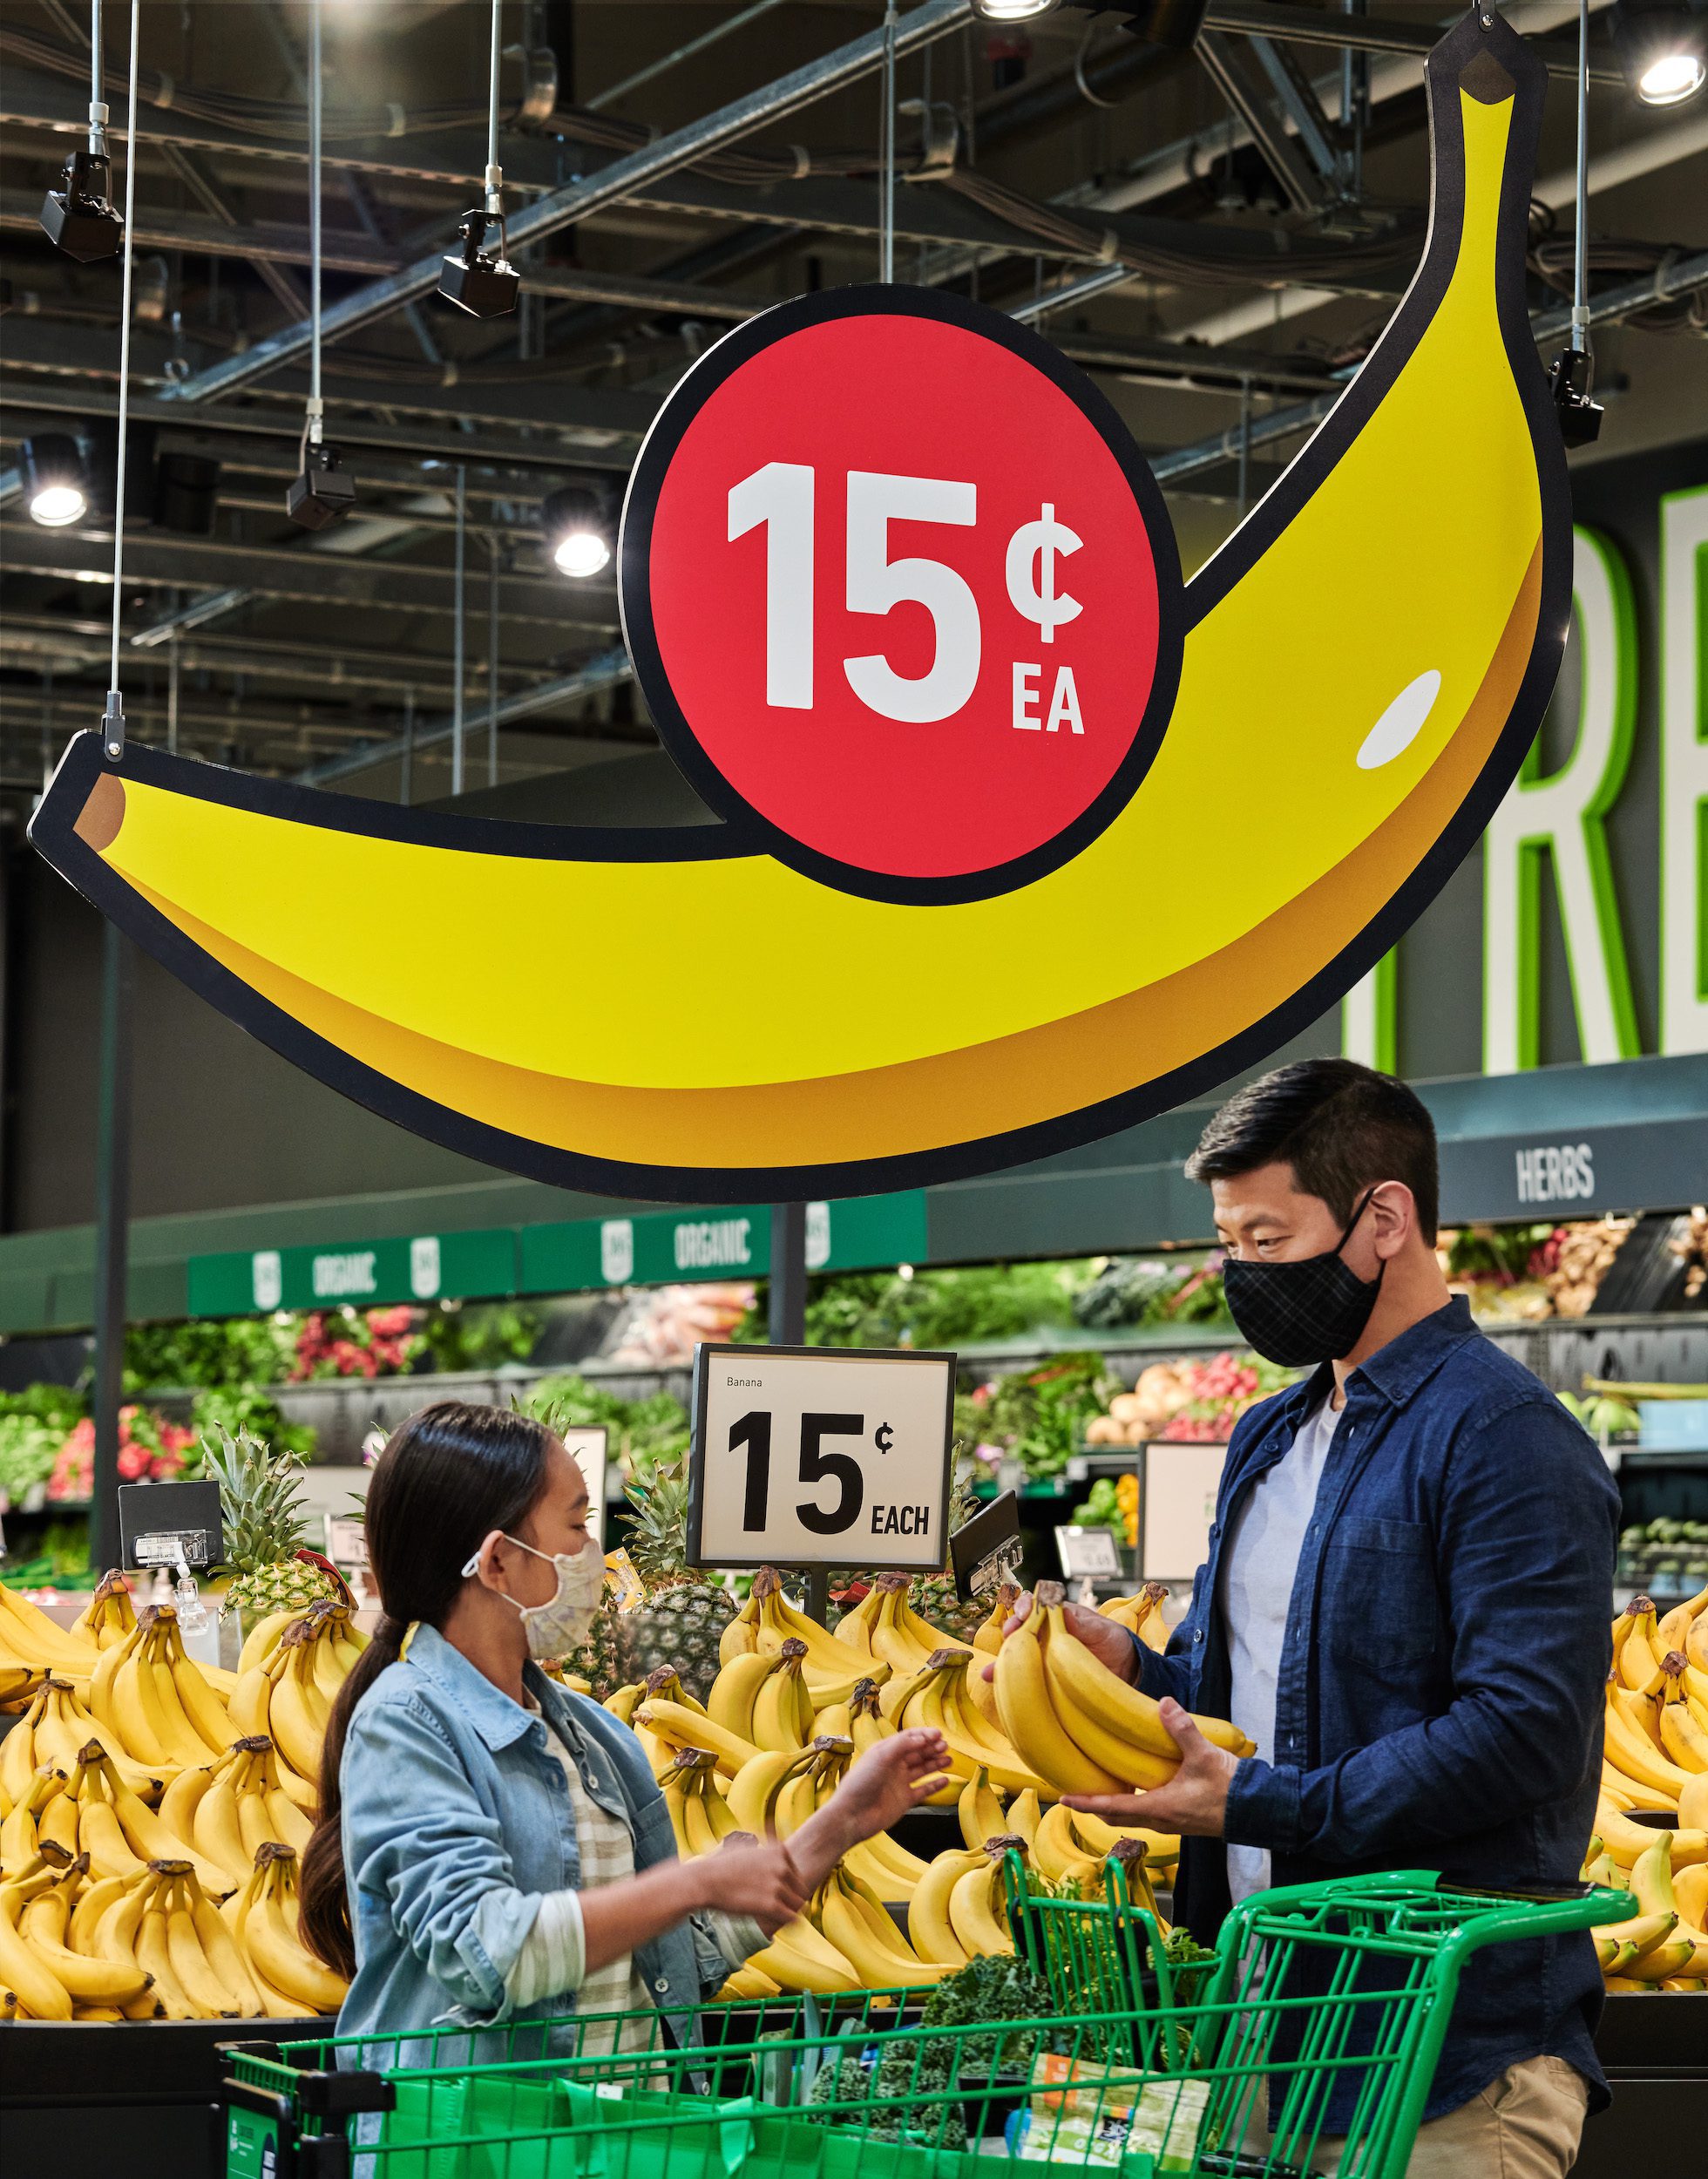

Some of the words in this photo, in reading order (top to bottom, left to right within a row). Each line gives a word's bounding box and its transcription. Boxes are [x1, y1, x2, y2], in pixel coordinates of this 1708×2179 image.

[1012, 662, 1085, 734] EA
[1516, 1143, 1595, 1202] HERBS
[674, 1218, 751, 1270] ORGANIC
[727, 1376, 763, 1388] Banana
[871, 1506, 930, 1536] EACH
